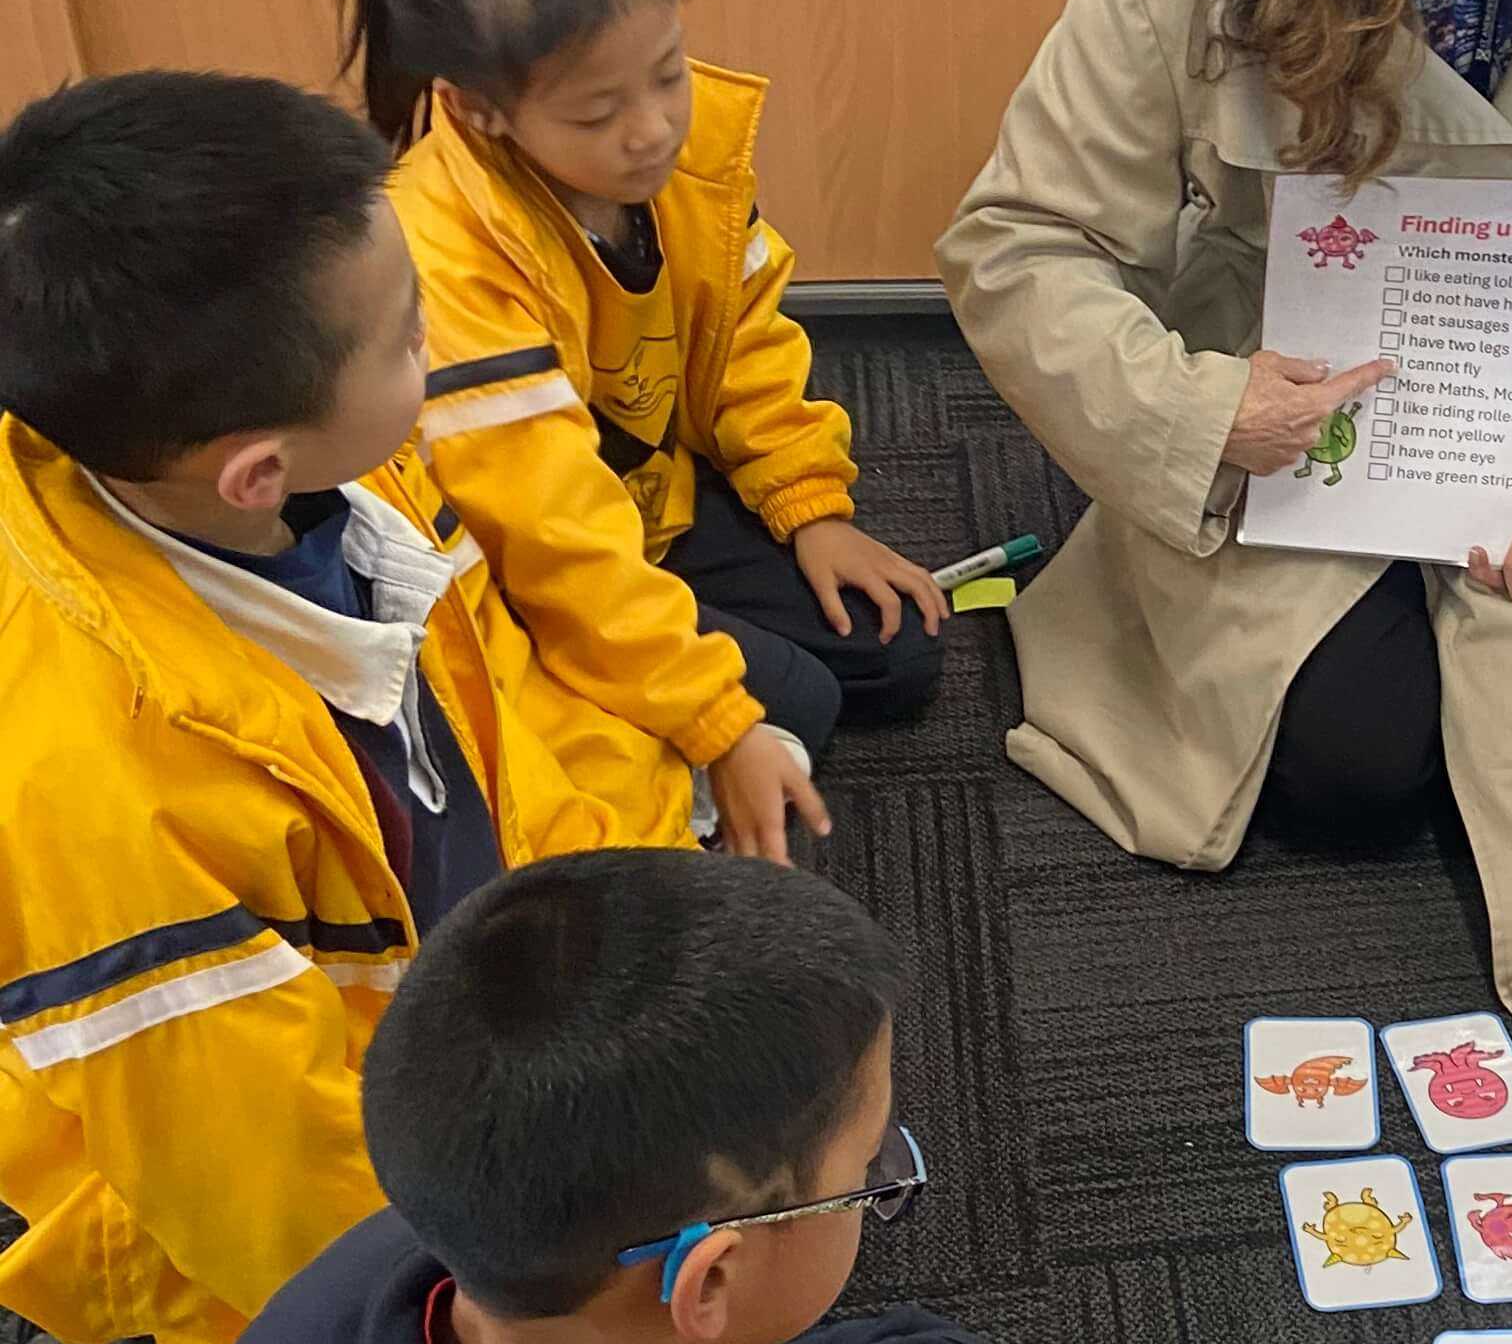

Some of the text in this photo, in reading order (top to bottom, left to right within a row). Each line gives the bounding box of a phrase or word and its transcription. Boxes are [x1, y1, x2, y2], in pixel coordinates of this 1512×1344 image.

[1401, 215, 1491, 240] Finding
[1398, 245, 1450, 259] Which
[1415, 269, 1440, 283] like
[1444, 273, 1491, 289] eating
[1412, 290, 1432, 303] do
[1435, 294, 1461, 306] not
[1464, 294, 1500, 309] have
[1411, 314, 1435, 326] eat
[1439, 317, 1509, 334] sausages
[1409, 334, 1445, 349] have
[1449, 339, 1476, 352] two
[1480, 341, 1510, 358] legs
[1407, 359, 1459, 374] cannot
[1464, 362, 1482, 378] fly
[1398, 379, 1435, 394] More
[1439, 382, 1489, 400] Maths,
[1403, 401, 1429, 415] like
[1432, 404, 1475, 422] riding
[1401, 426, 1424, 436] am
[1429, 428, 1452, 439] not
[1457, 430, 1505, 443] yellow
[1399, 445, 1434, 459] have
[1438, 450, 1465, 462] one
[1470, 453, 1496, 466] eye
[1397, 467, 1432, 480] have
[1435, 472, 1477, 485] green
